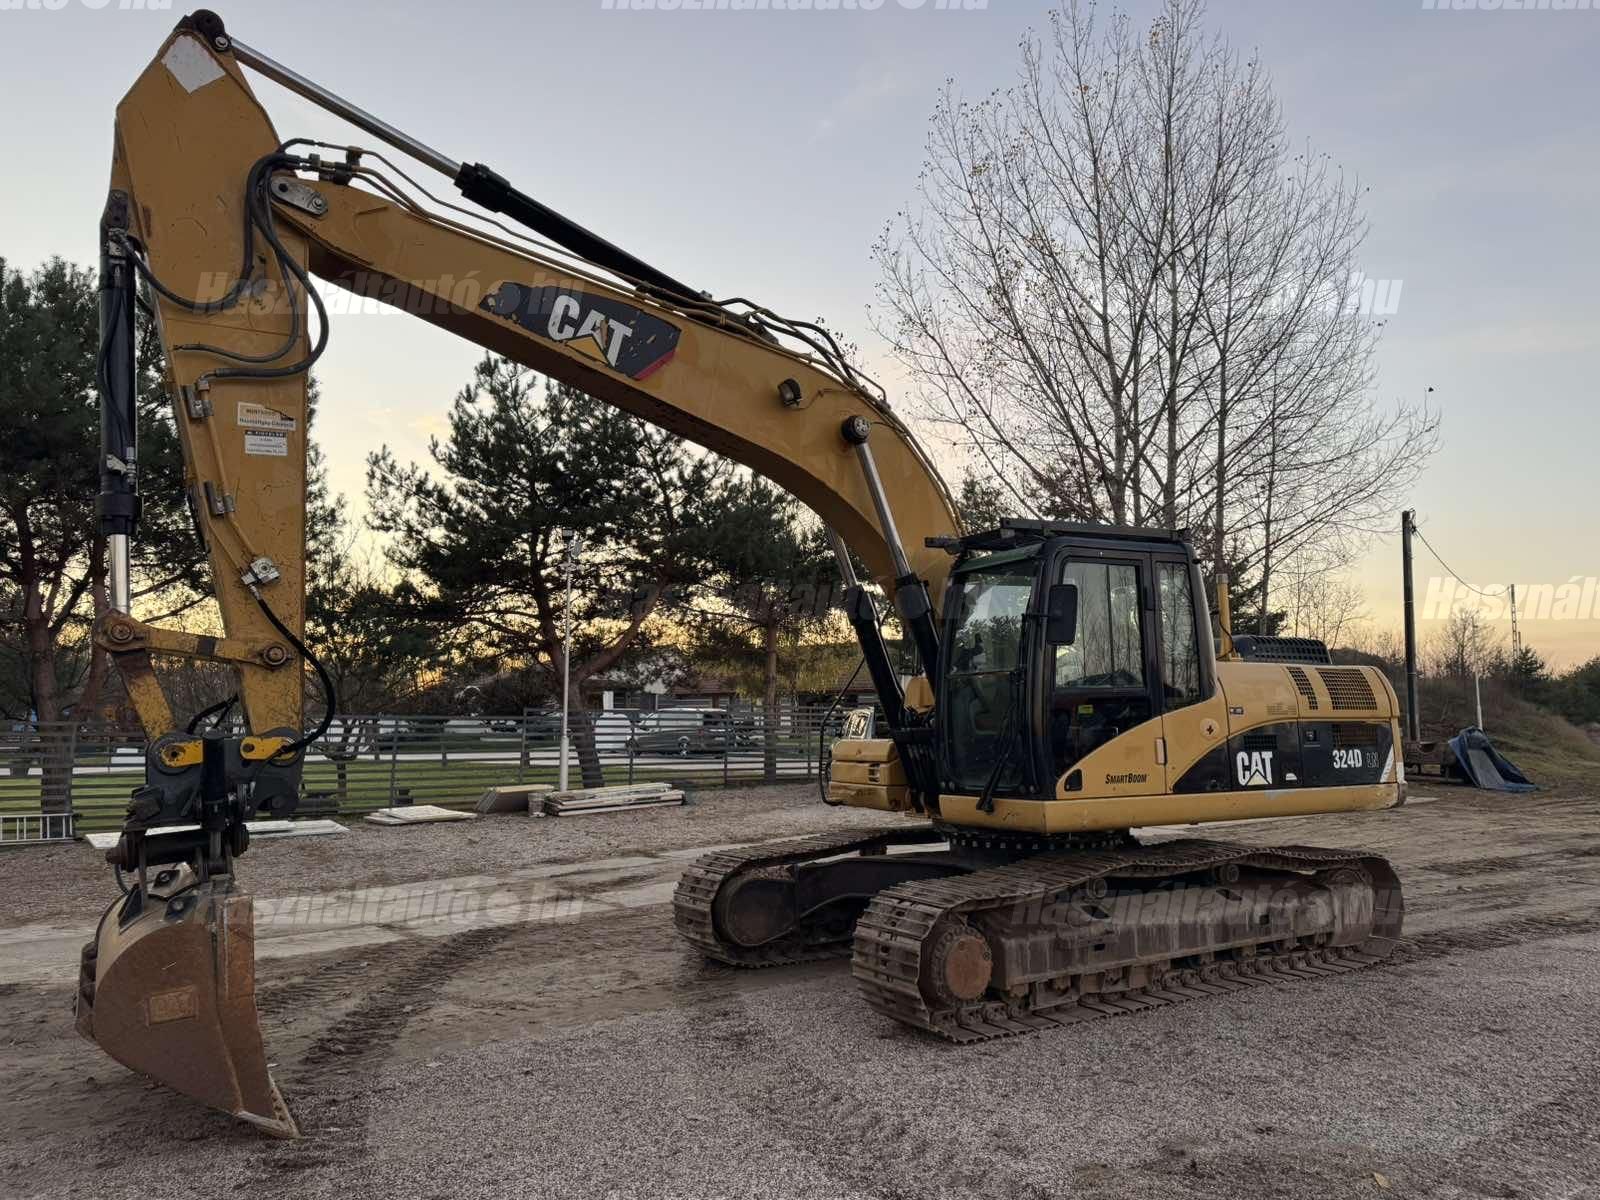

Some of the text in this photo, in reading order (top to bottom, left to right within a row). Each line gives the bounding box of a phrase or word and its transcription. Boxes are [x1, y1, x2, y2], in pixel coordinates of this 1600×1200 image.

[548, 294, 633, 368] CAT
[1236, 751, 1273, 786] CAT
[1332, 749, 1362, 769] 324D
